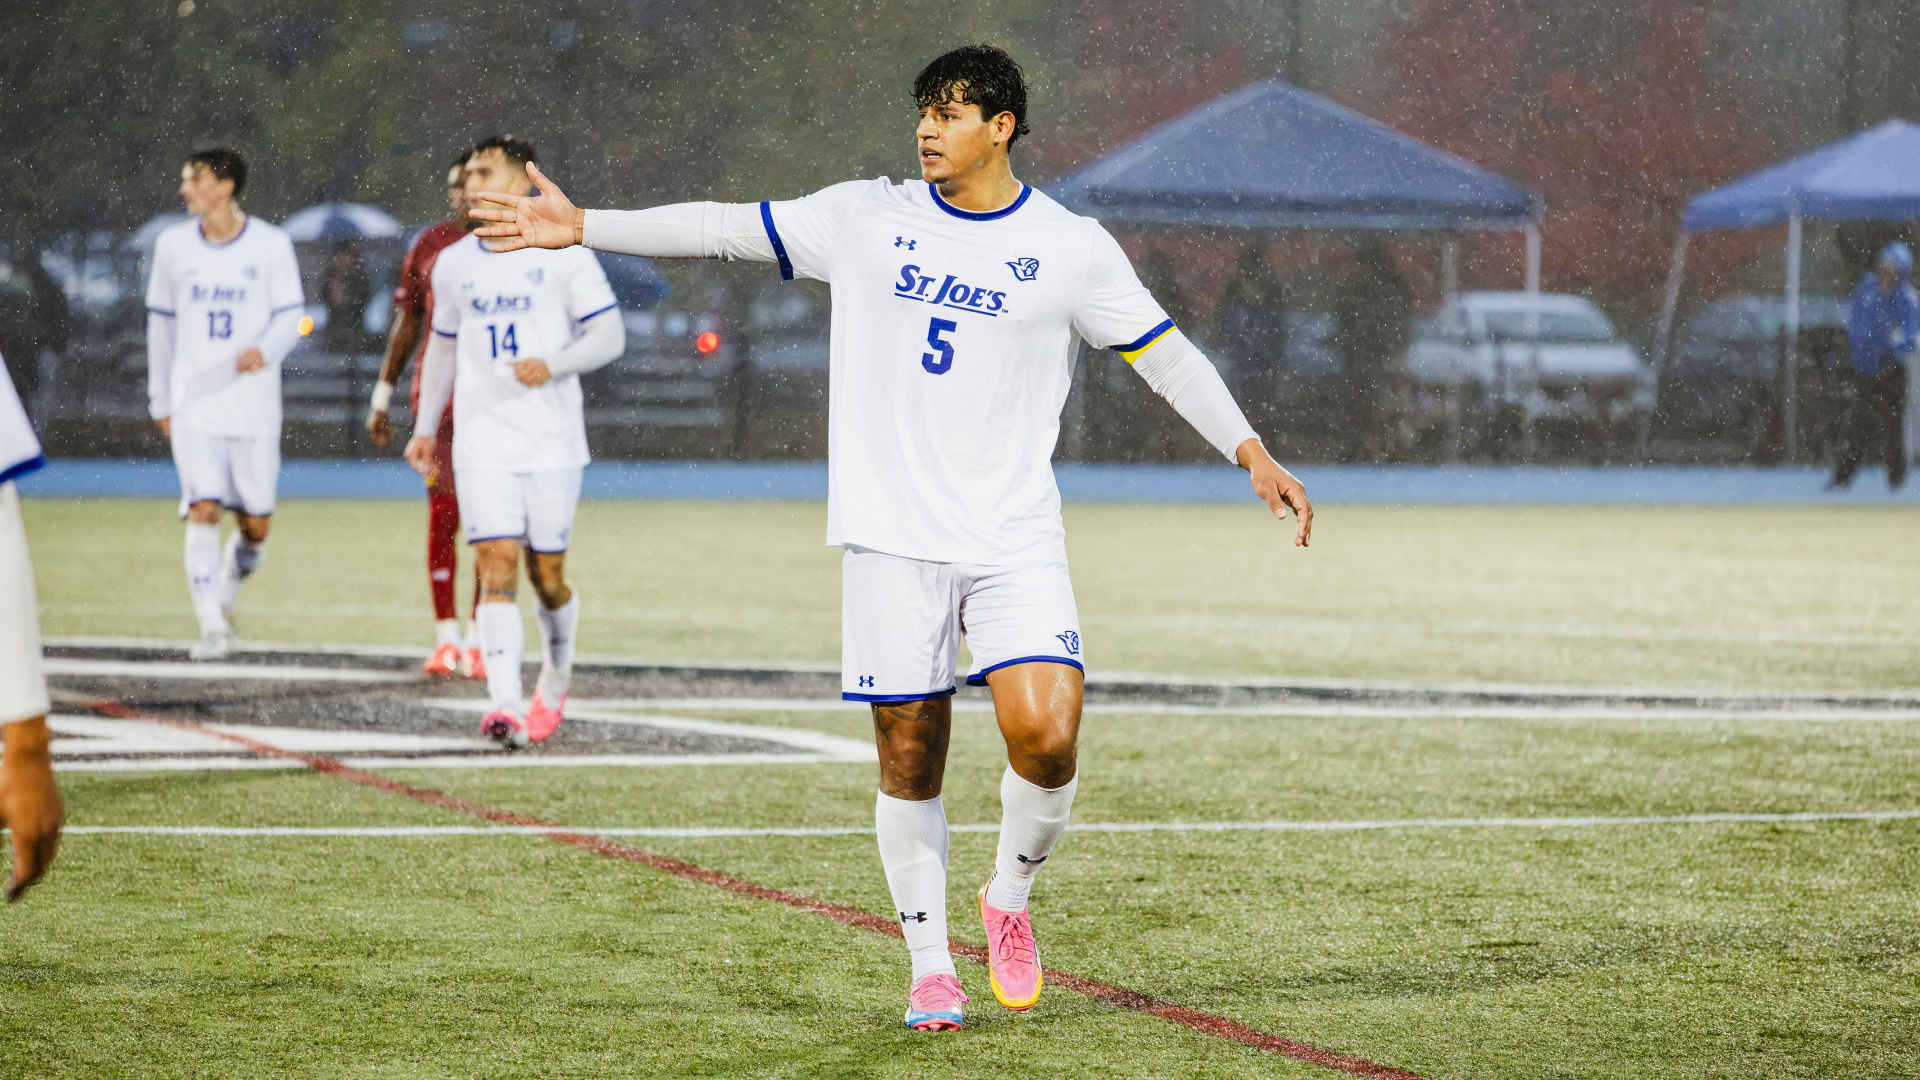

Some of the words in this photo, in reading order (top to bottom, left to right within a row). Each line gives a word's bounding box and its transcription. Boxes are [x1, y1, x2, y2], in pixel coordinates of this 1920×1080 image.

[927, 274, 1007, 311] JOE'S
[208, 311, 232, 339] 13
[487, 323, 518, 358] 14
[922, 317, 957, 375] 5
